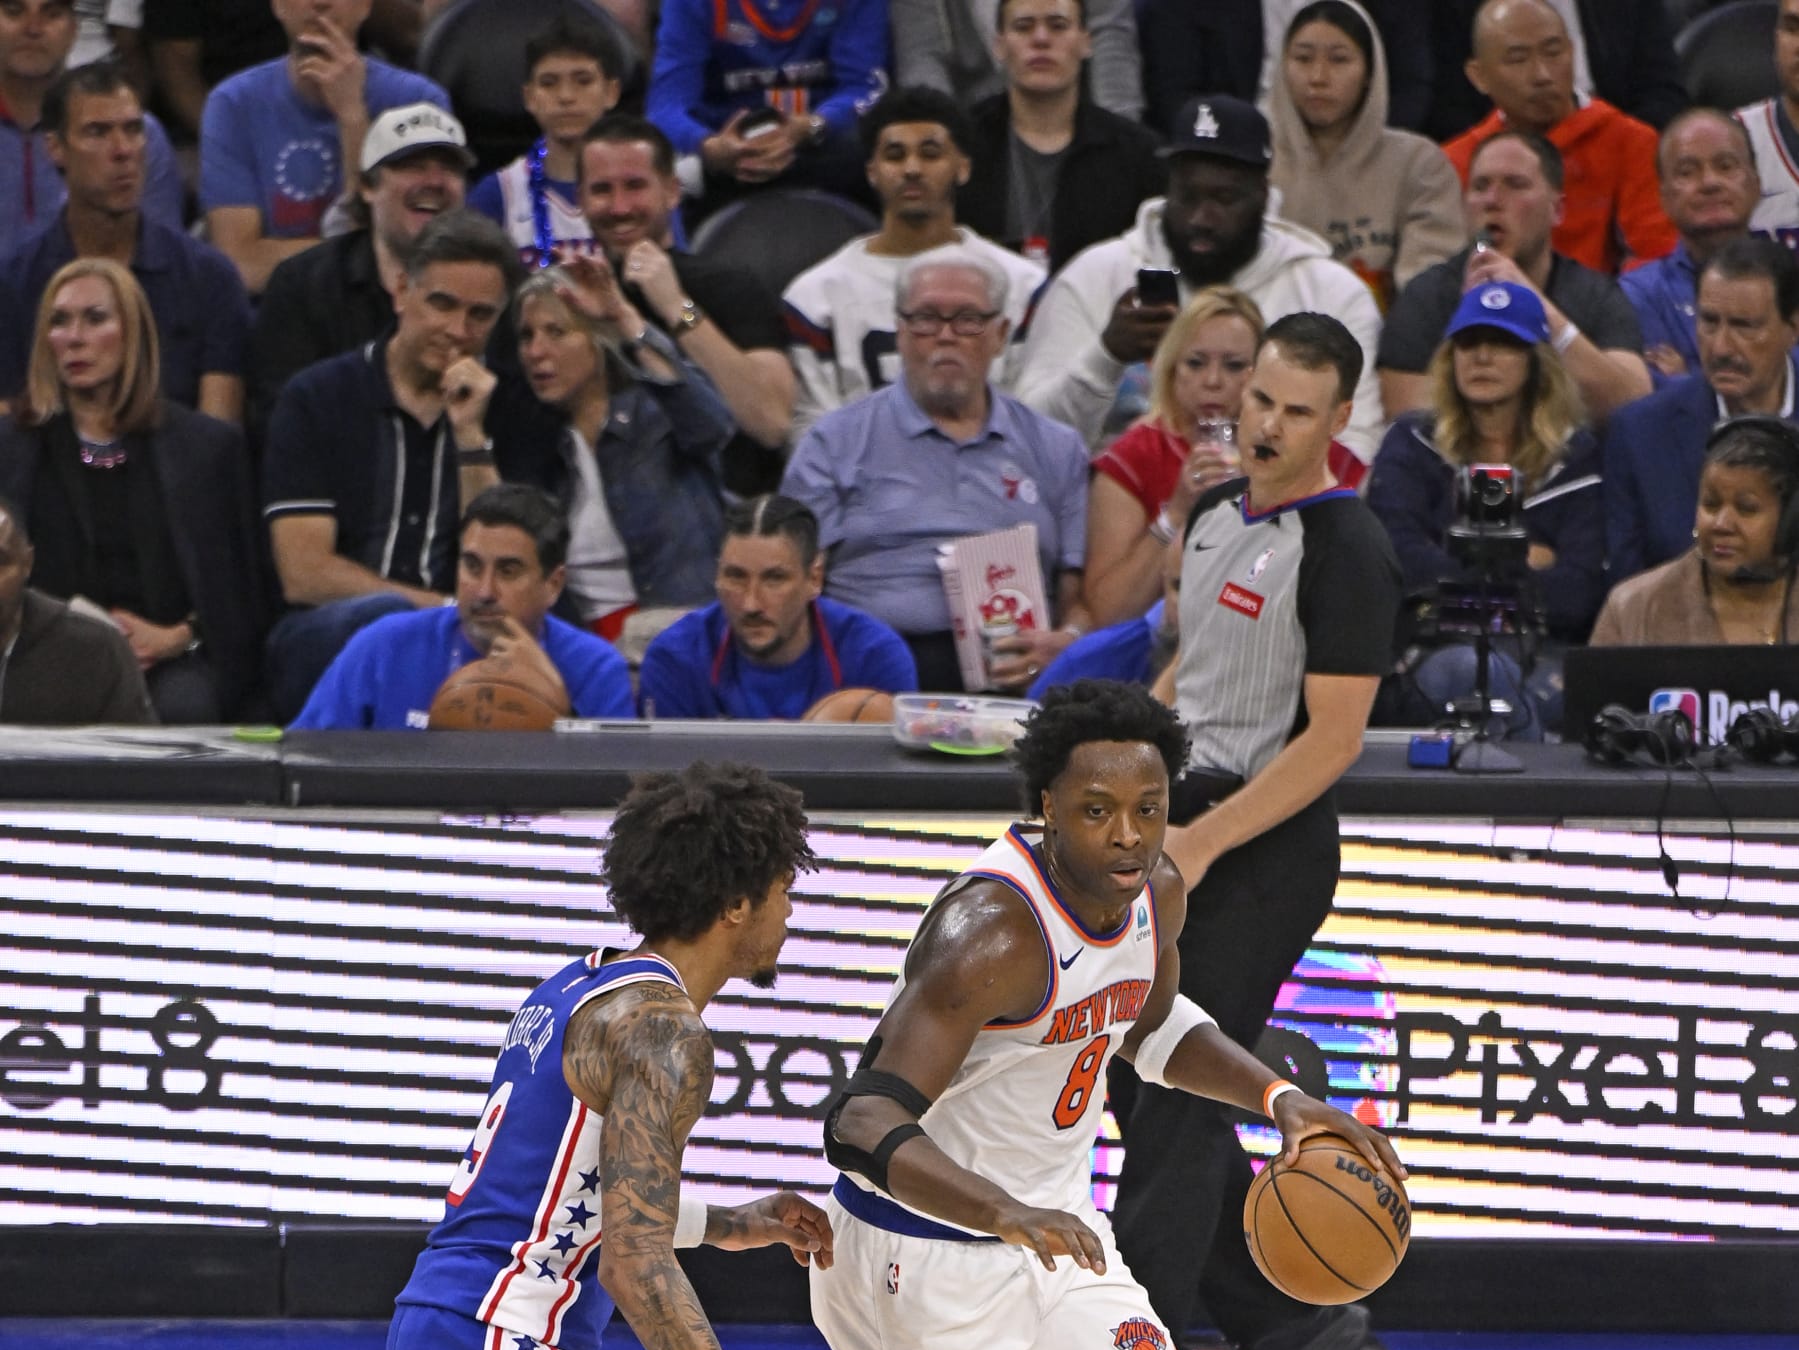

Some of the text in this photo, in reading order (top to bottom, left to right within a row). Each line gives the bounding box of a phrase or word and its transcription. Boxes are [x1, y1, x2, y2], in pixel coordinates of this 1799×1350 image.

[148, 999, 223, 1112] 8
[1040, 990, 1108, 1045] NEW
[1397, 1006, 1698, 1126] Pixel
[1052, 1033, 1110, 1130] 8
[446, 1081, 514, 1208] 9
[1113, 1320, 1166, 1346] KNICKS
